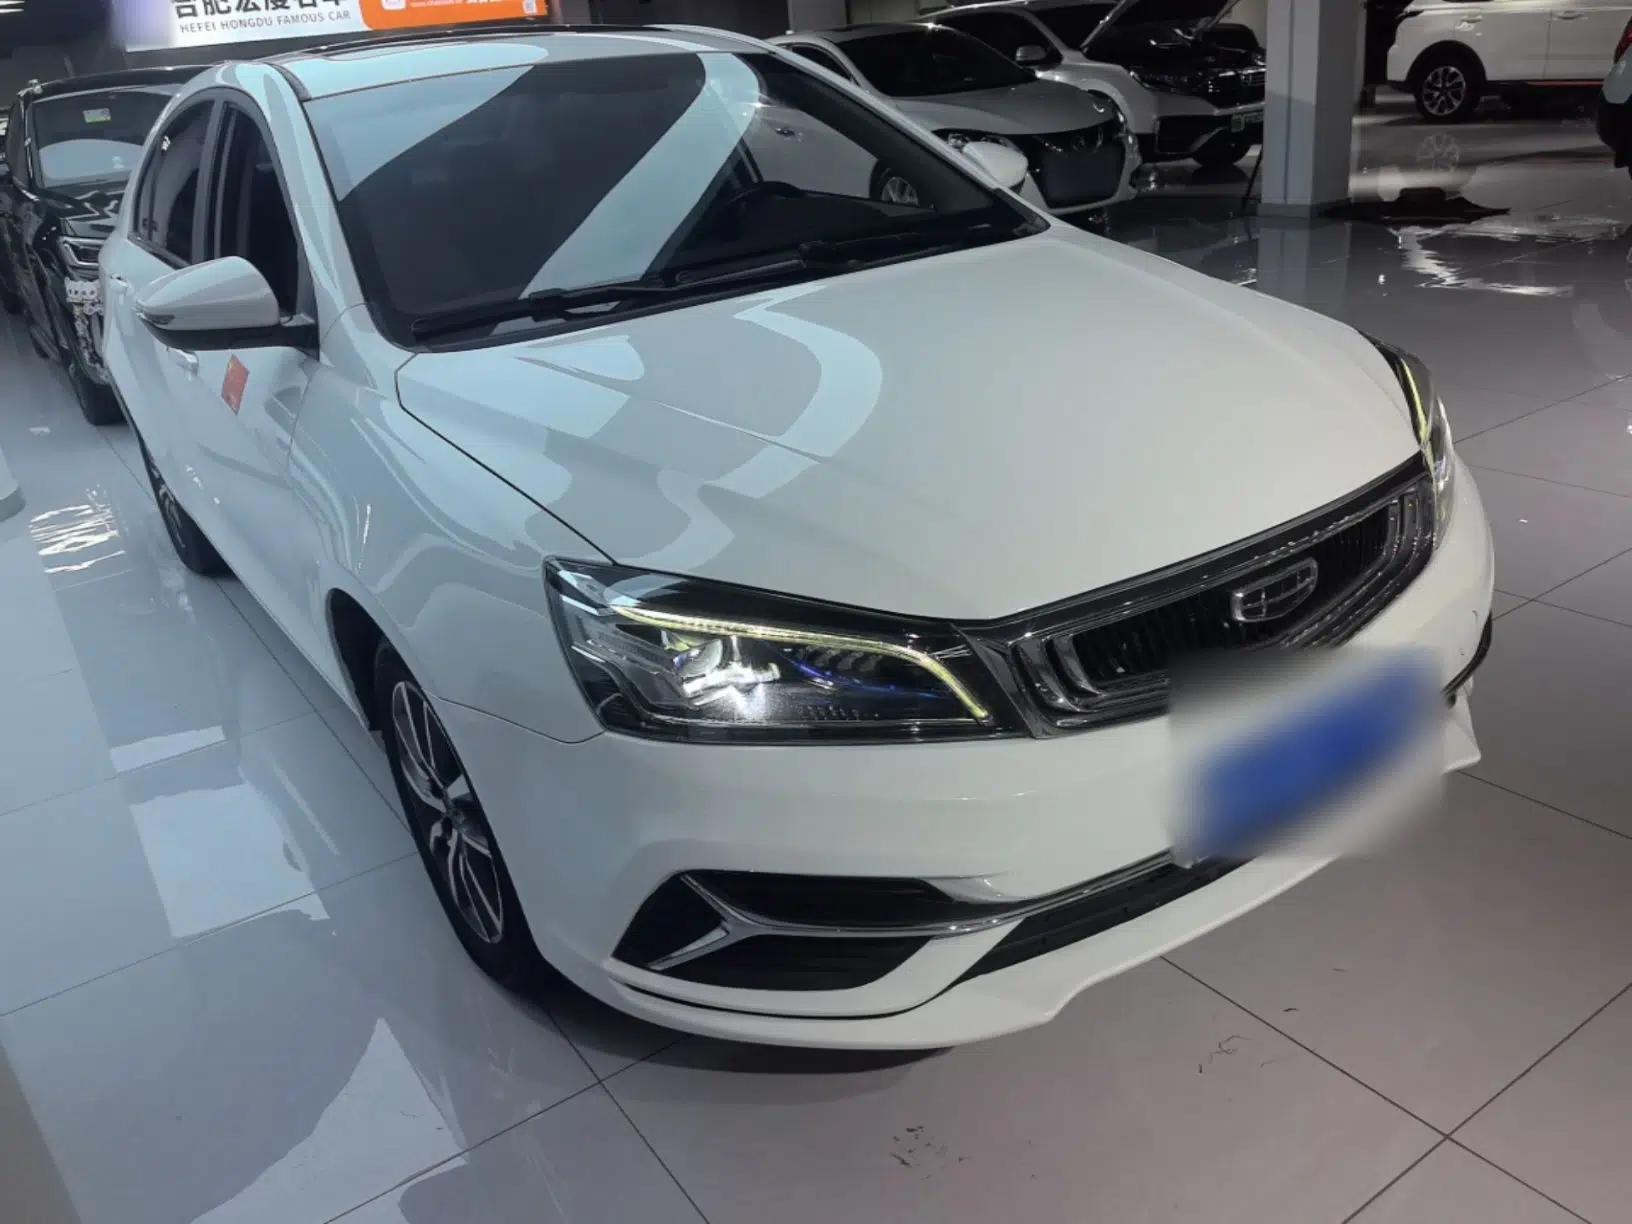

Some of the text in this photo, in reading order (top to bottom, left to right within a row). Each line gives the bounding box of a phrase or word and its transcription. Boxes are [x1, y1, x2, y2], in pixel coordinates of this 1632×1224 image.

[220, 16, 273, 30] HONGDU
[276, 12, 325, 25] FAMOUS
[327, 10, 351, 21] CAR
